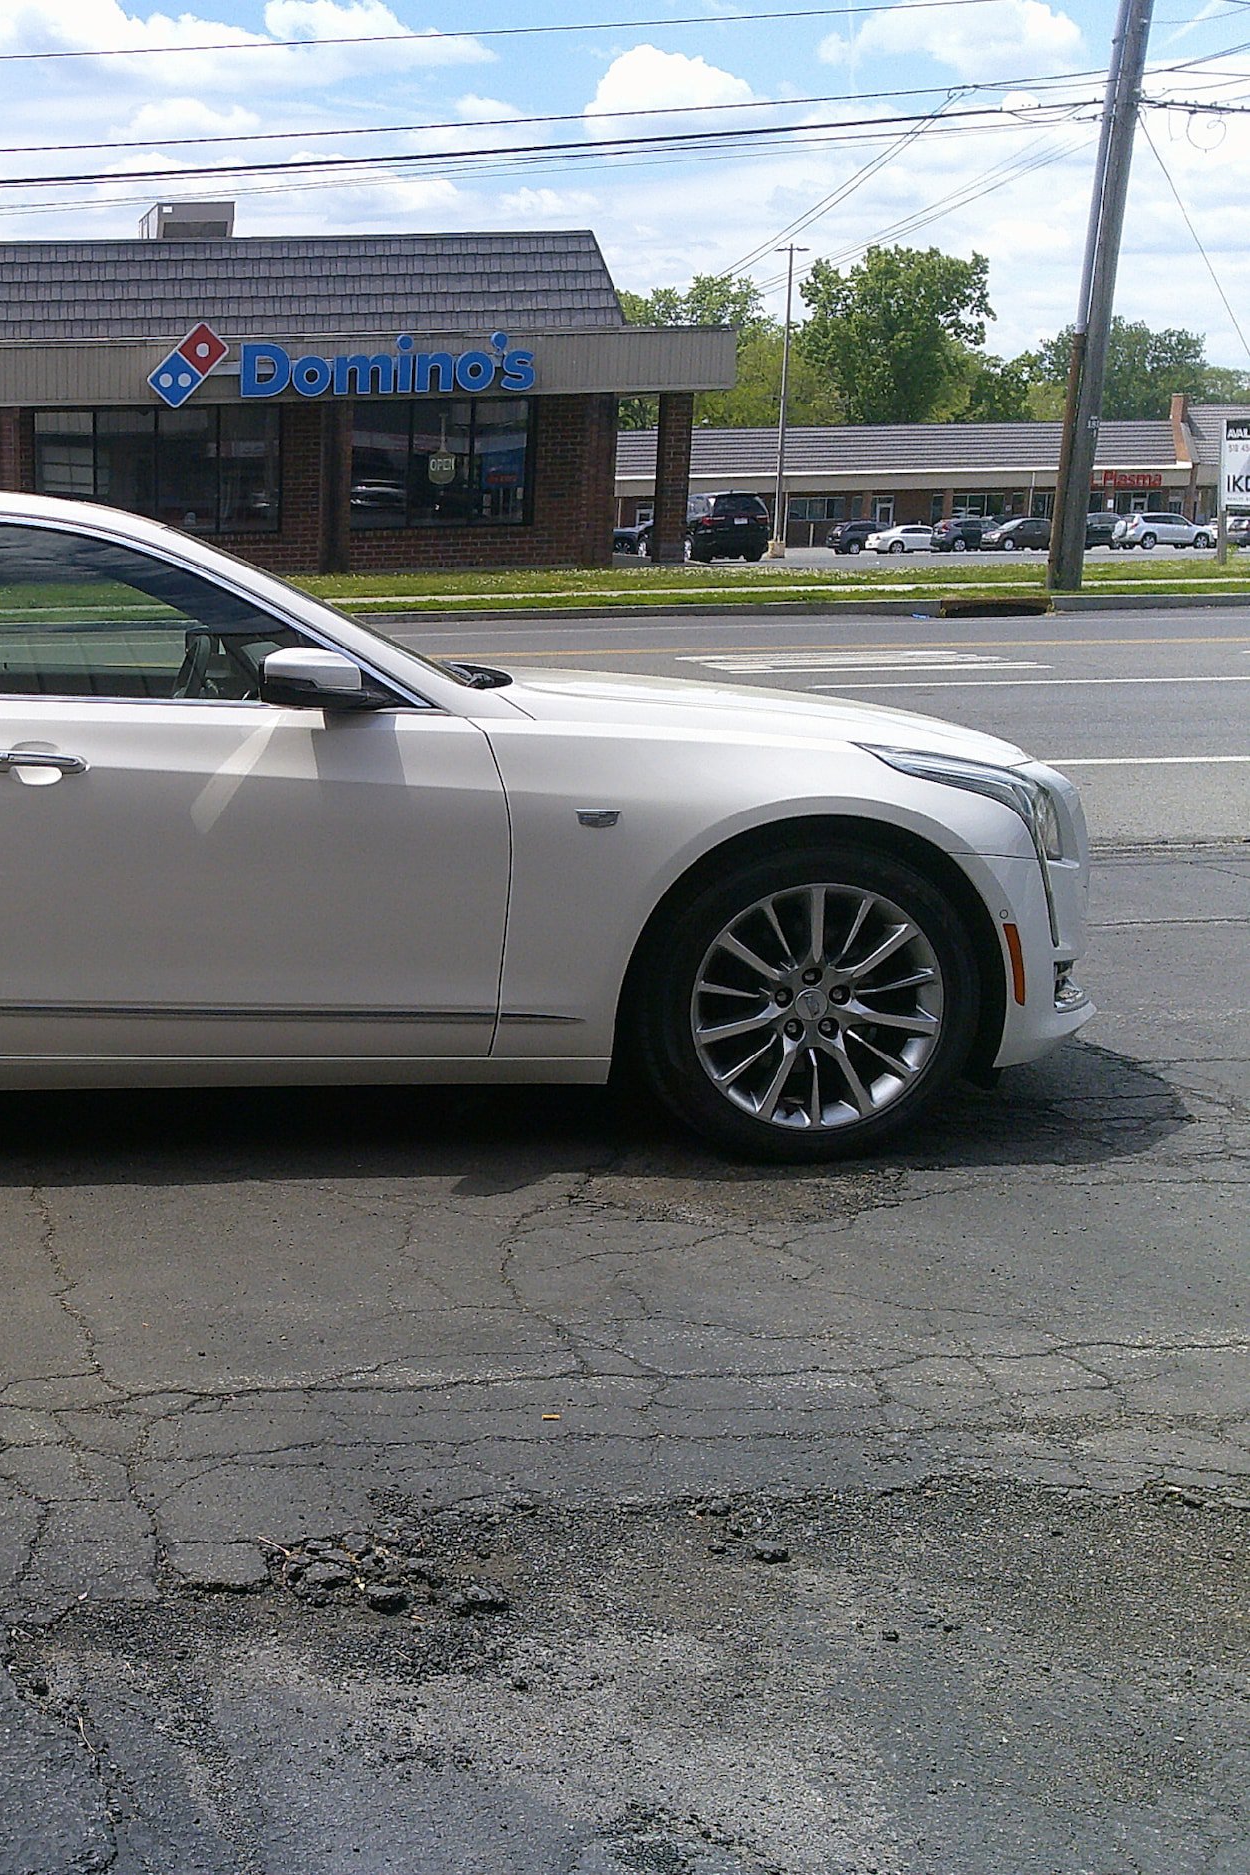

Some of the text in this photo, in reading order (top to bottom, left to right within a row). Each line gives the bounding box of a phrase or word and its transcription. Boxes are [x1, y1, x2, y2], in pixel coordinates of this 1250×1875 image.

[240, 331, 535, 398] Domino's
[430, 458, 455, 471] OPEN
[1103, 469, 1162, 487] Plasma
